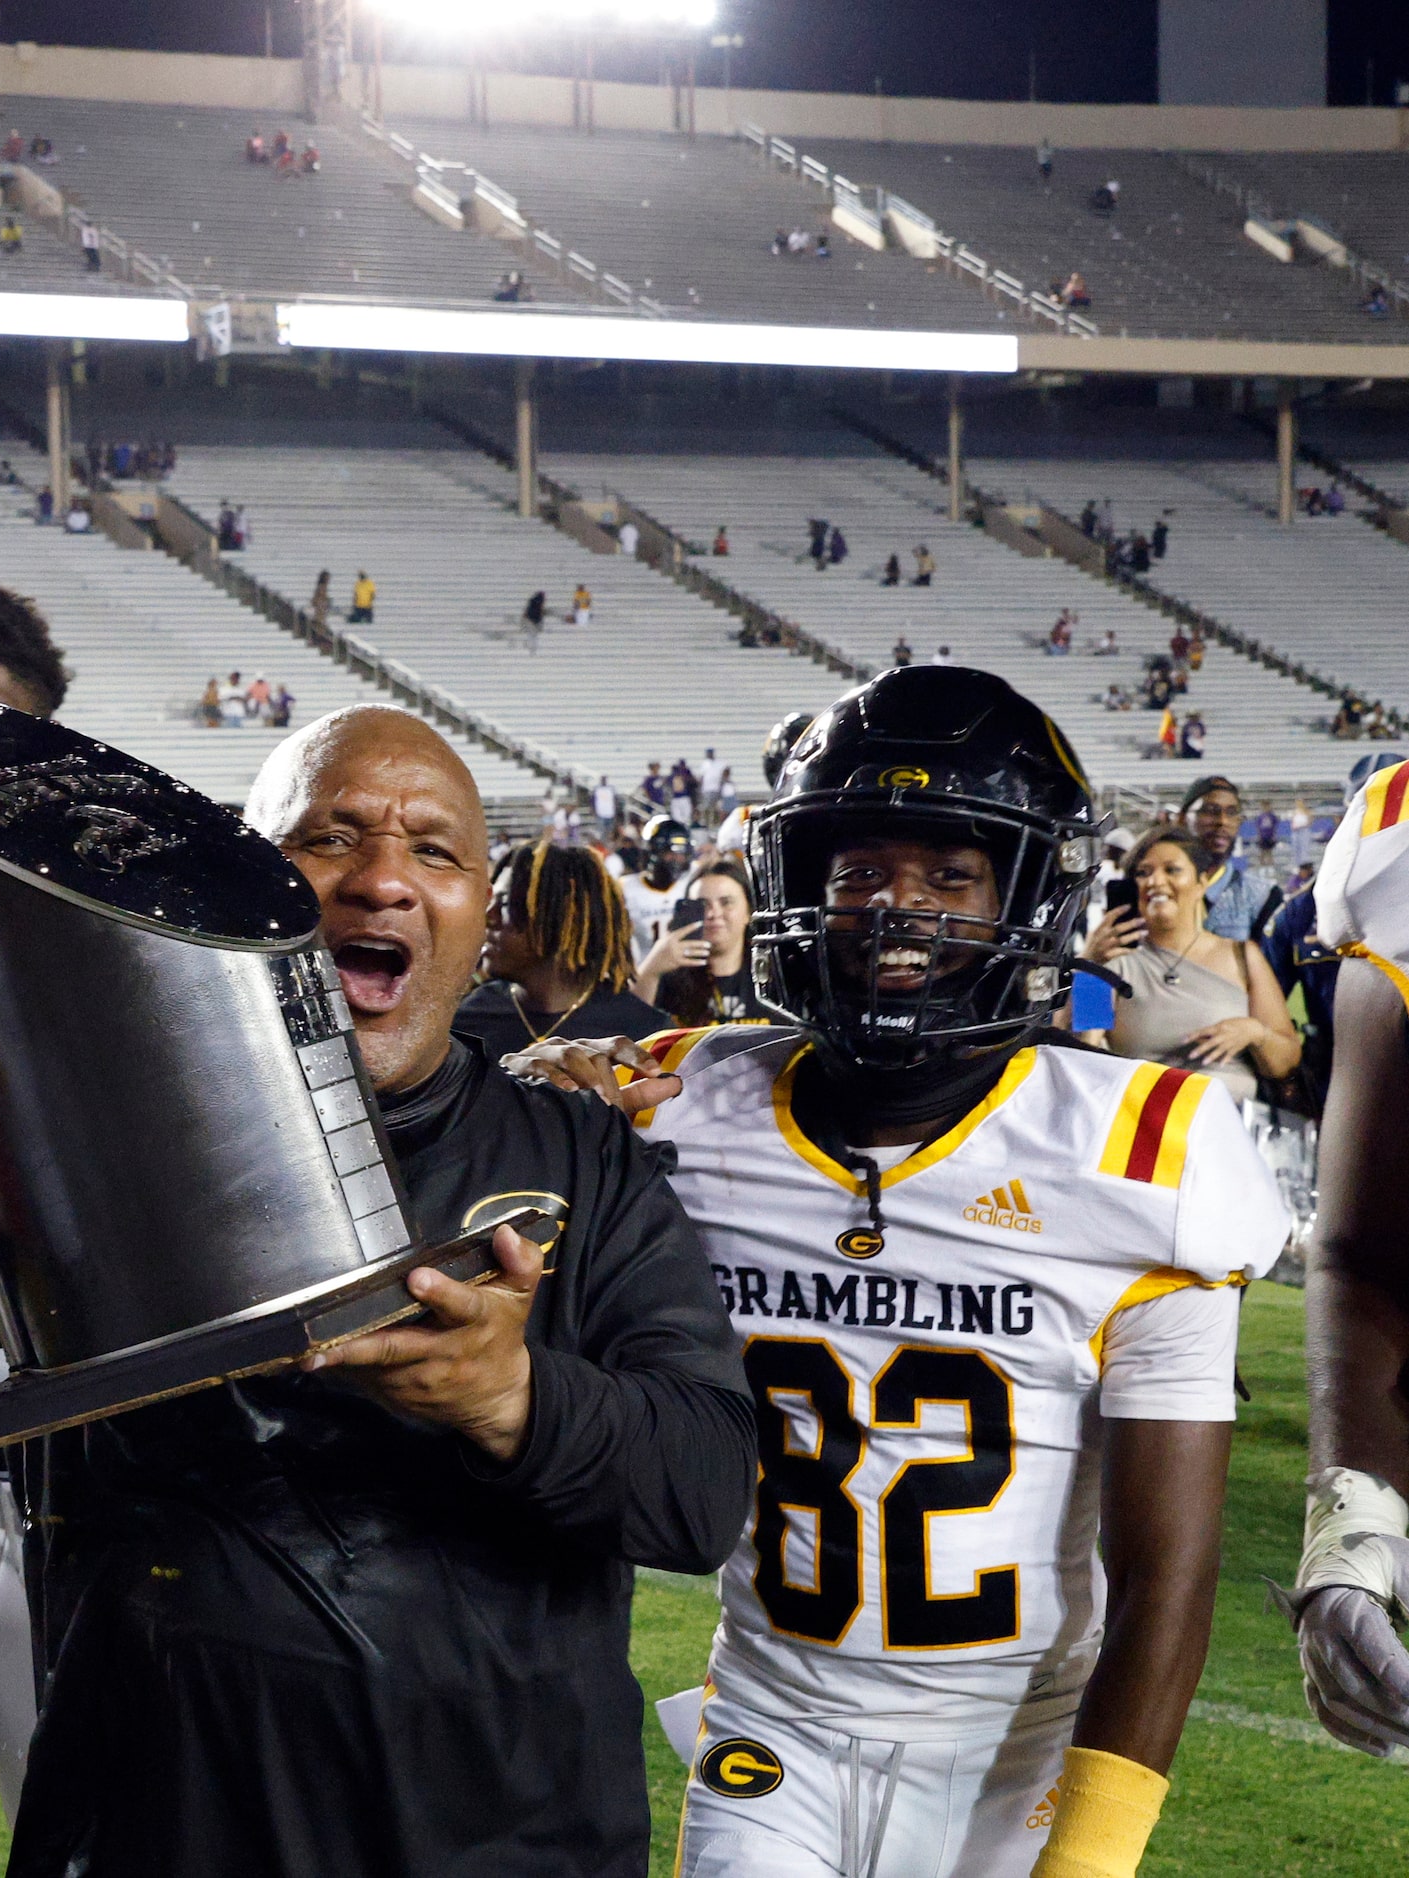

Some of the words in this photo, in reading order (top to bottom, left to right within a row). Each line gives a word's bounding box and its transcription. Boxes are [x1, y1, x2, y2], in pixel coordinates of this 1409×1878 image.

[963, 1206, 1043, 1234] adidas
[742, 1333, 1021, 1651] 82
[700, 1737, 784, 1798] G
